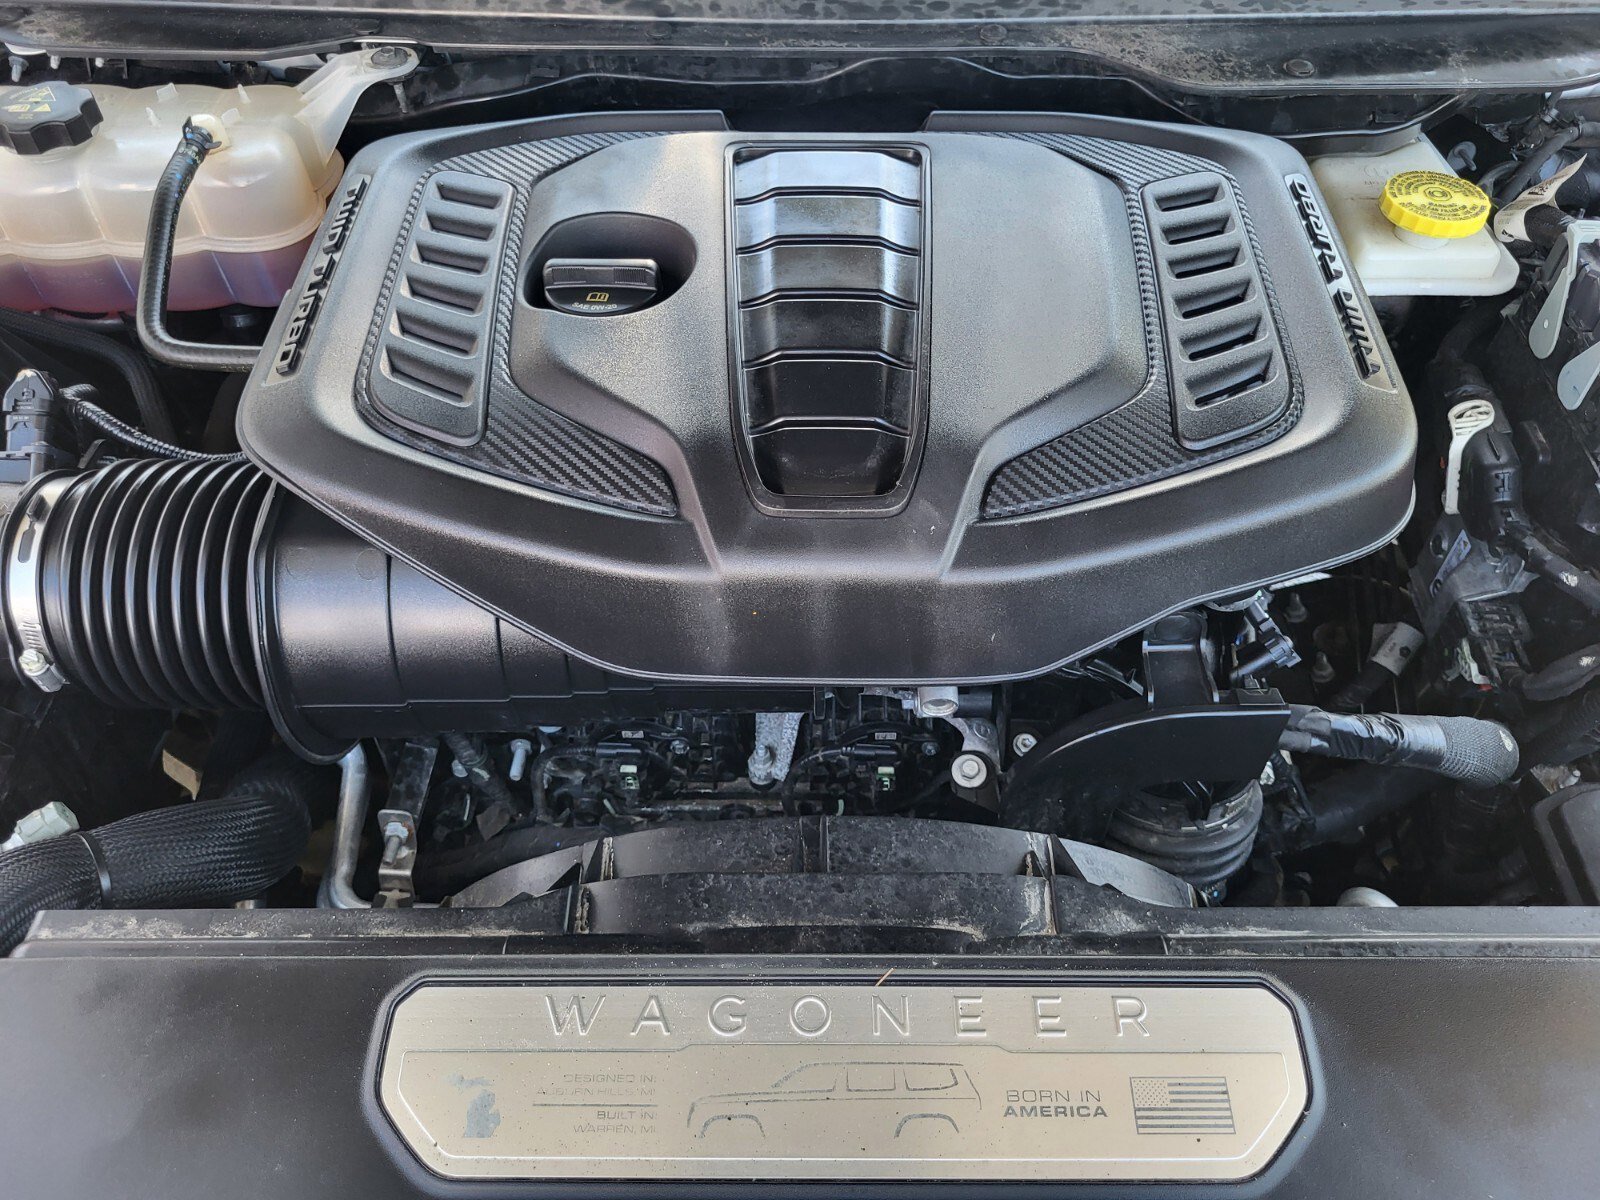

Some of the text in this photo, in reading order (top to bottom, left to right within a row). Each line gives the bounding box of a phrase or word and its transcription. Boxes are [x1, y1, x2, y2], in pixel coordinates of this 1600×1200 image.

[276, 178, 368, 376] TWIN TURBO
[1289, 179, 1381, 379] TWIN TURBO
[572, 302, 589, 310] SAE
[545, 994, 1151, 1037] WAGONEER
[564, 1074, 636, 1083] DESIGNED
[1006, 1089, 1101, 1102] BORN IN
[597, 1110, 637, 1120] BUILT
[1003, 1105, 1108, 1118] AMERICA
